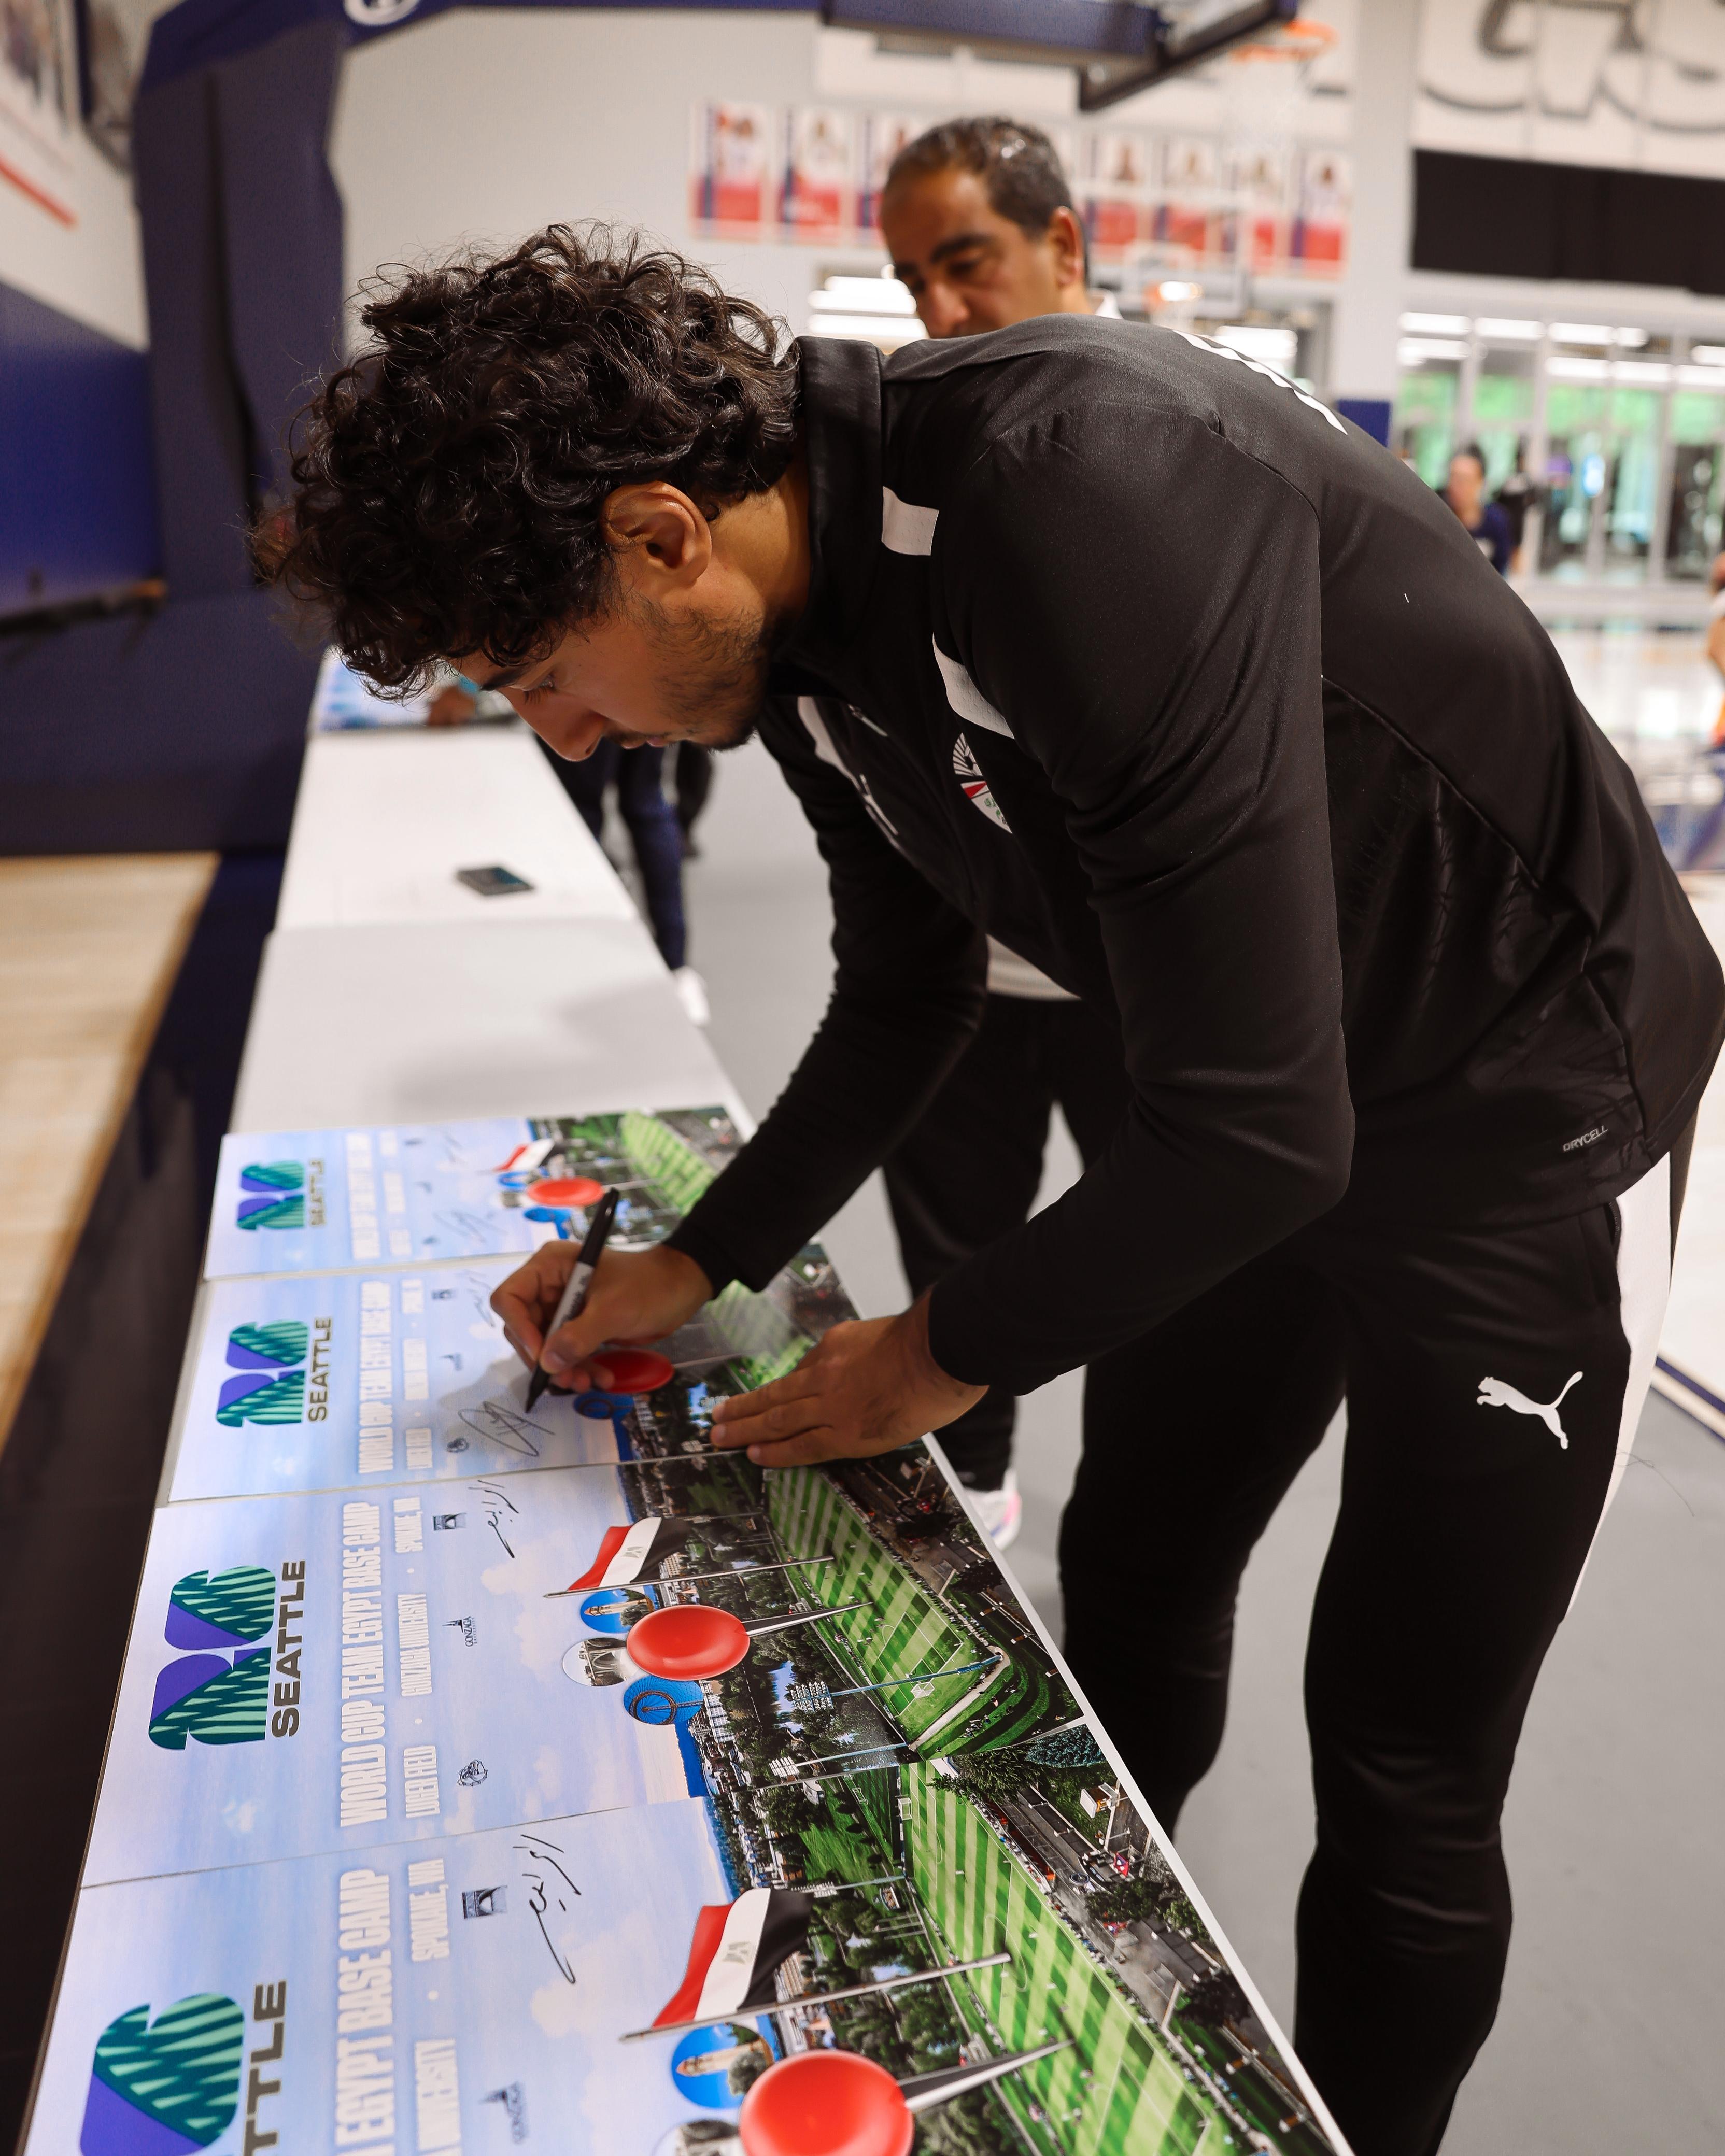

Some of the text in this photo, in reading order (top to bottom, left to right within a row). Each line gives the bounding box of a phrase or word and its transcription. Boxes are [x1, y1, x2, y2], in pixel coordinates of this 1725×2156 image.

[1562, 1125, 1608, 1152] DRYCELL
[307, 1318, 332, 1422] SEATTLE
[270, 1561, 306, 1738] SEATTLE
[340, 1502, 387, 1827] WORLD CUP TEAM EGYPT BASE CAMP
[398, 1593, 432, 1697] GONZAGA UNIVERSITY
[463, 1616, 474, 1647] GONZAGA
[403, 1745, 440, 1818] LUGER FIELD
[338, 1869, 392, 1951] CAMP
[337, 1949, 393, 2035] BASE
[79, 1992, 245, 2156] 6
[242, 1980, 286, 2156] TTLE
[335, 2034, 395, 2145] EGYPT
